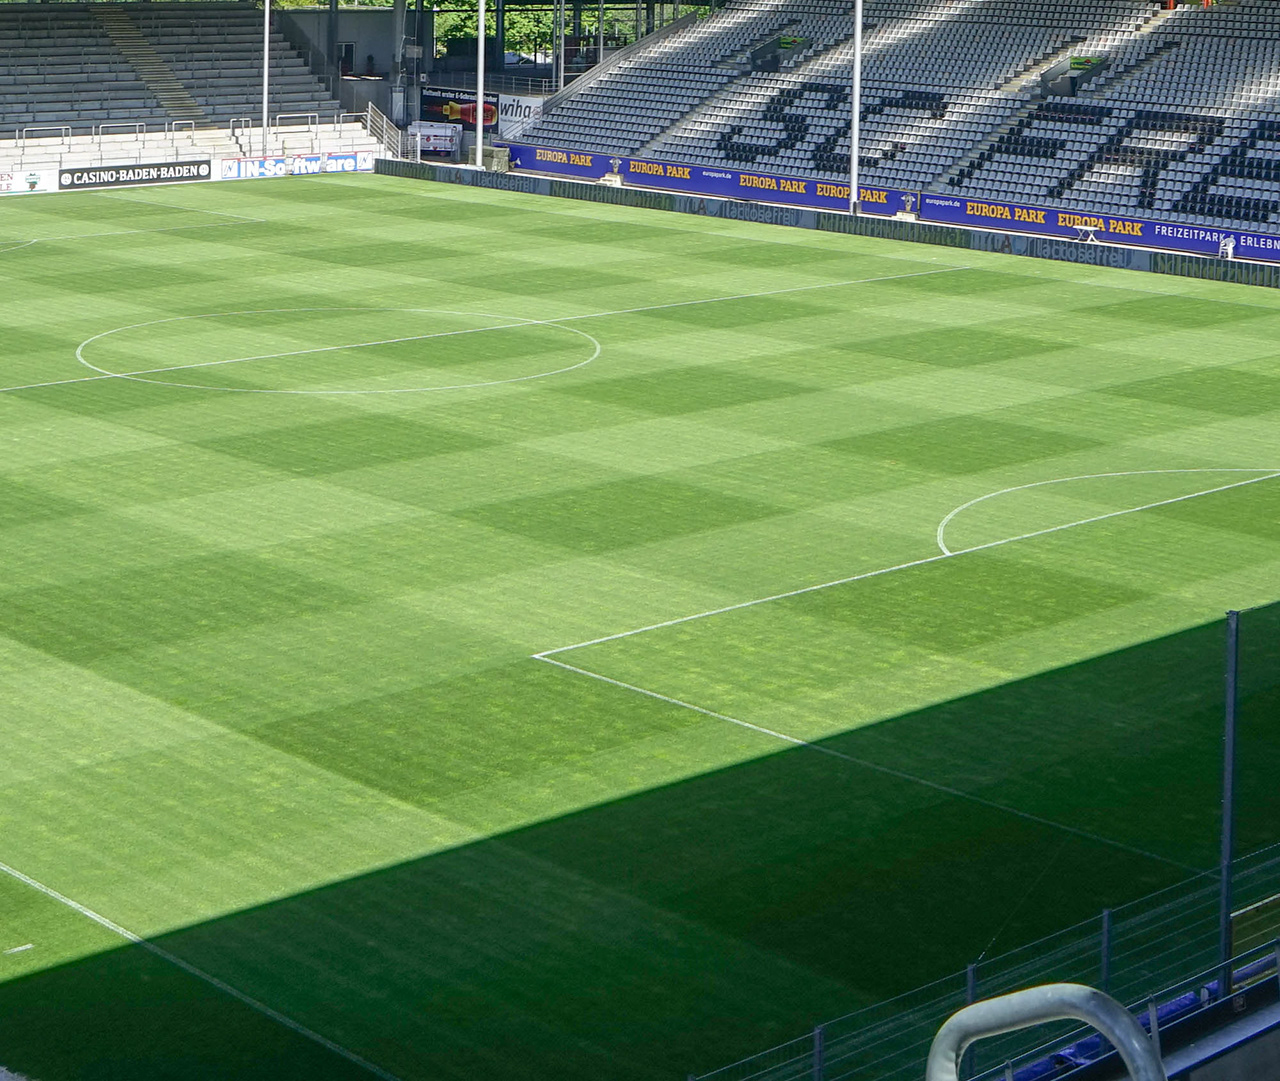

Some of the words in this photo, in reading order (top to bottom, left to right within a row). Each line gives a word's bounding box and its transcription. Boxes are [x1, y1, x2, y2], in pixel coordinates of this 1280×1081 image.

[500, 98, 532, 119] wiha
[536, 149, 569, 165] EUROPA
[570, 153, 593, 167] PARK
[629, 160, 665, 177] EUROPA
[666, 165, 691, 180] PARK
[702, 171, 732, 180] europapark.de
[739, 174, 778, 191] EUROPA
[780, 179, 807, 194] PARK
[816, 183, 852, 201] EUROP
[860, 188, 888, 203] PARK
[926, 198, 961, 208] europapark.de
[966, 202, 1012, 221] EUROPA
[1014, 207, 1047, 225] PARK
[1058, 212, 1104, 233] EUROPA
[1108, 218, 1143, 237] PARK
[1154, 224, 1226, 242] FREIZEITPARK
